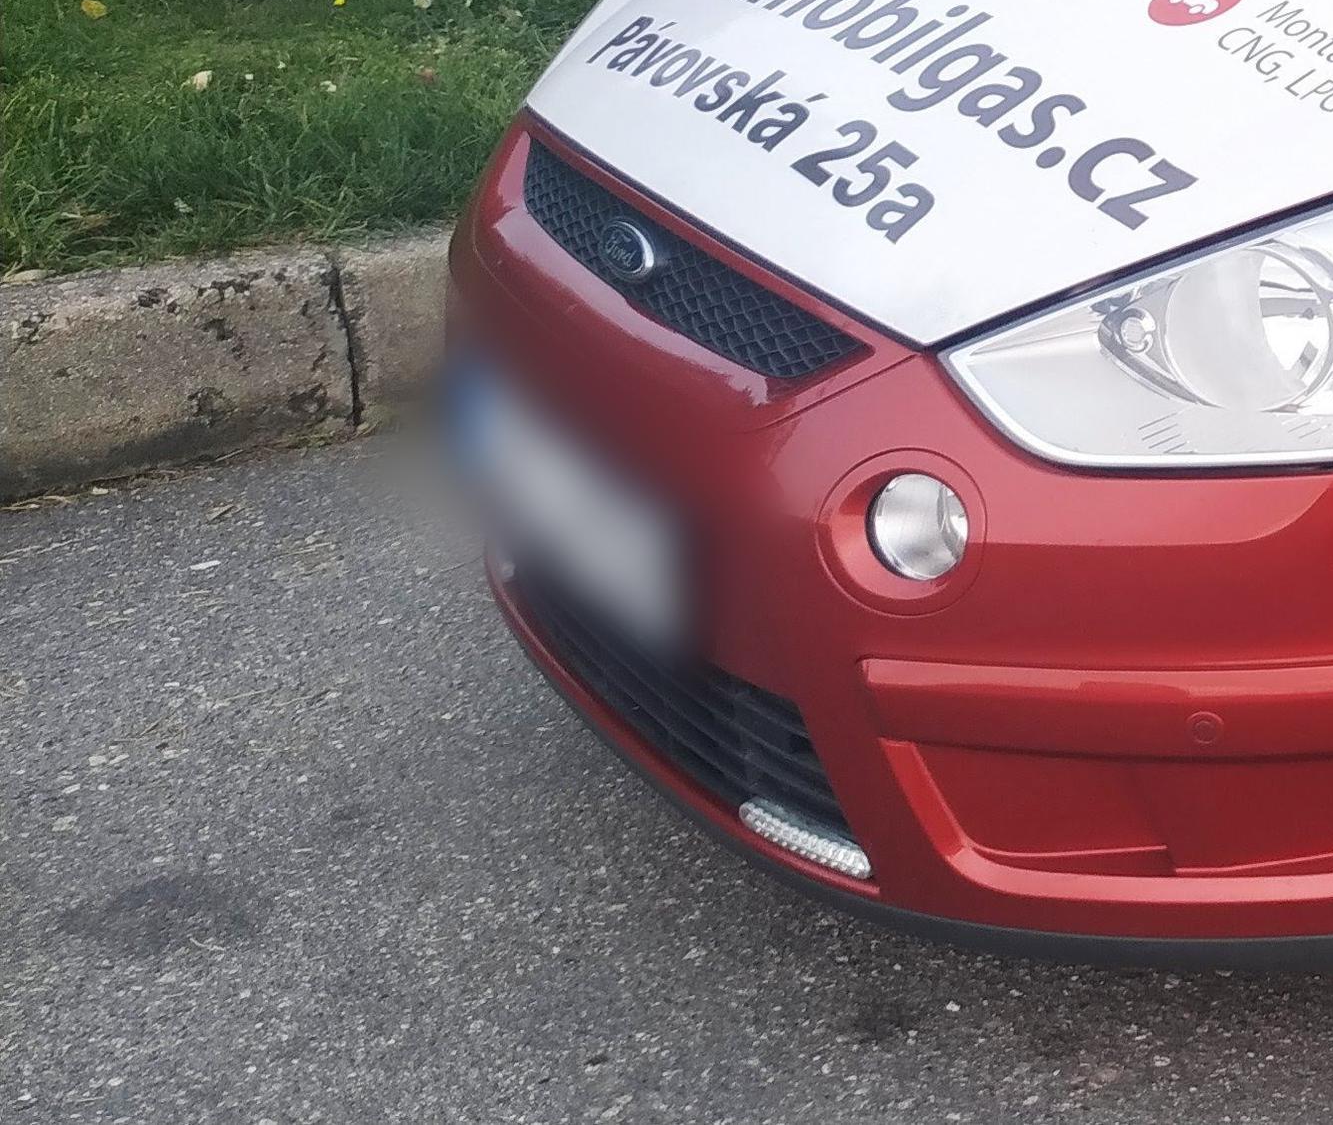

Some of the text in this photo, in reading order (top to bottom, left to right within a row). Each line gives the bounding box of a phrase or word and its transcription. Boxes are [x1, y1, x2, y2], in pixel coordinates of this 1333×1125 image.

[1217, 27, 1296, 84] CNG,
[586, 14, 937, 244] Pávovská 25a
